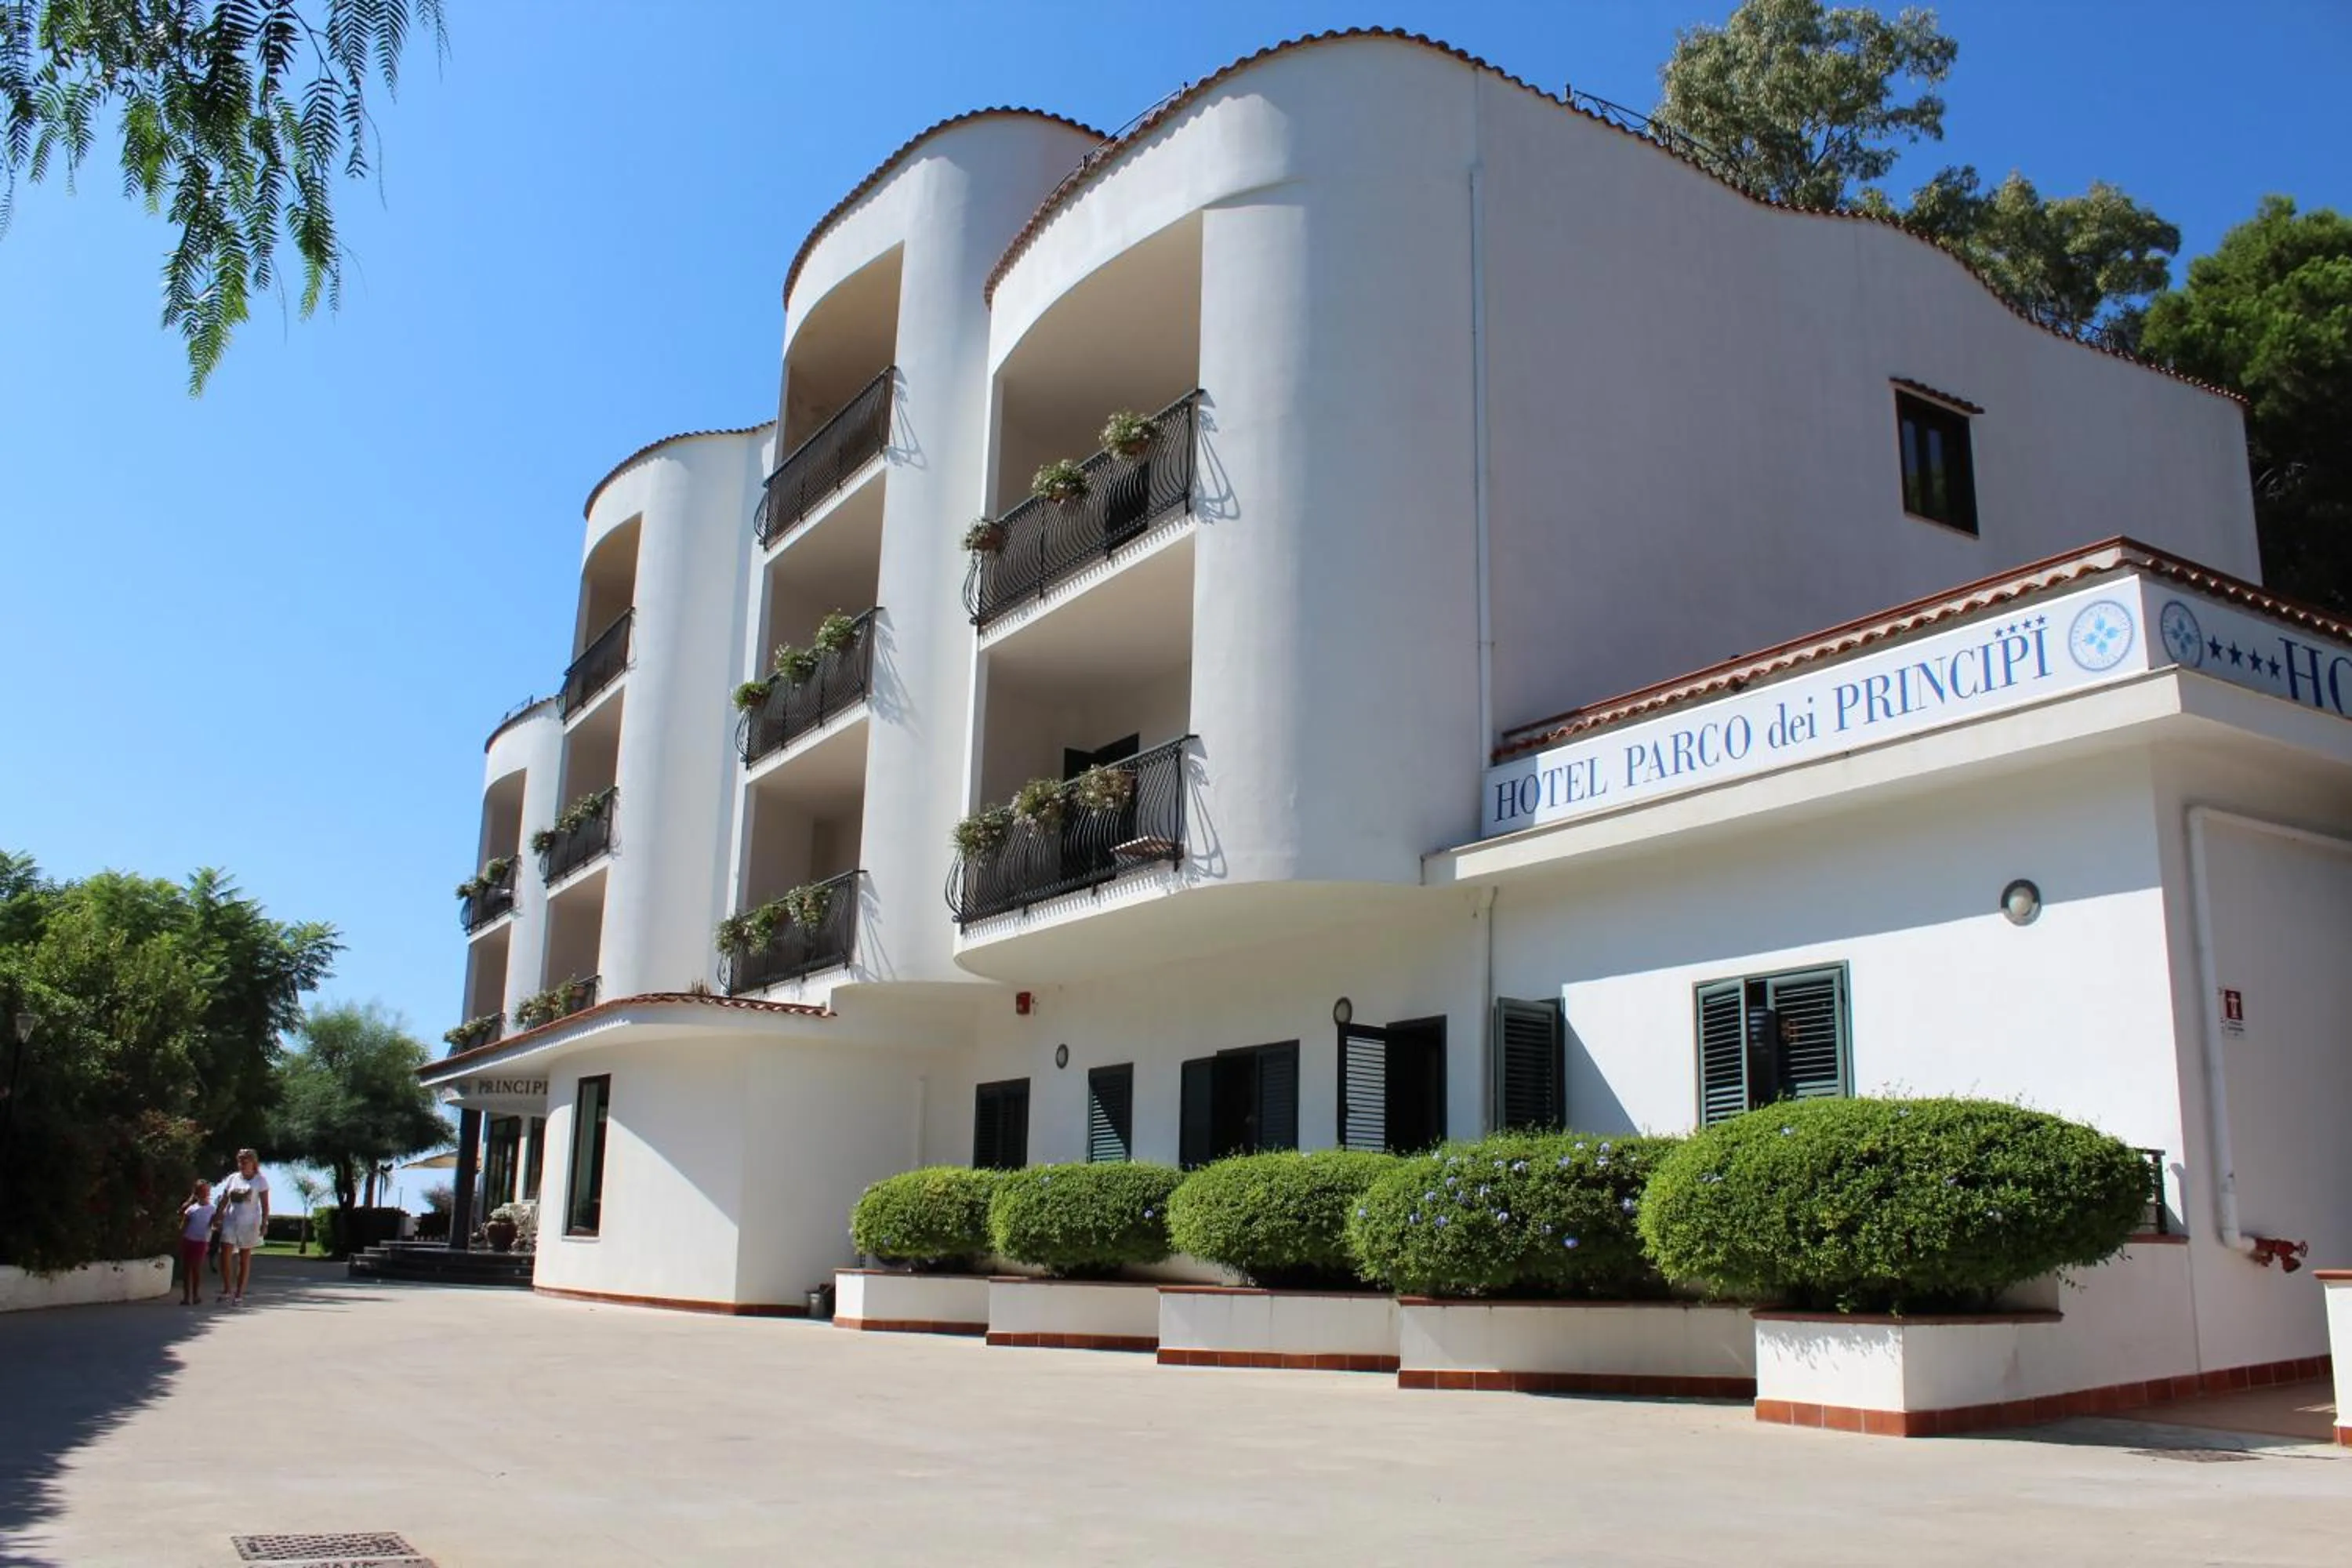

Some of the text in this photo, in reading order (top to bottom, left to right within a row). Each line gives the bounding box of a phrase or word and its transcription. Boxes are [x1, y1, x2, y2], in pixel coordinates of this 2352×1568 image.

[1494, 757, 1607, 822] HOTEL
[1623, 714, 1751, 789] PARCO
[1767, 695, 1817, 750] dei
[1831, 626, 2053, 732] PRINCIPI
[477, 1079, 549, 1096] PRINCIPI
